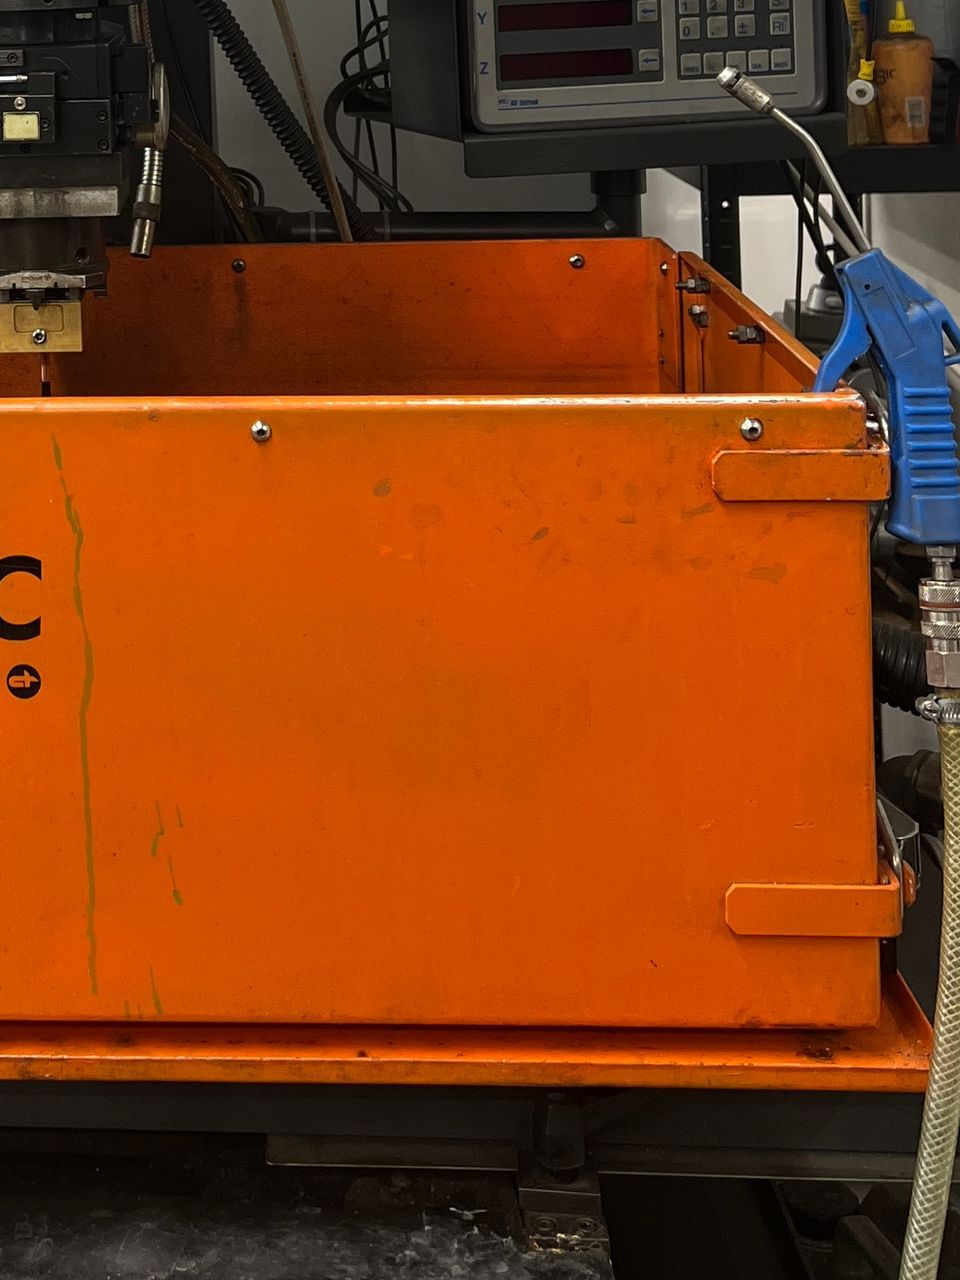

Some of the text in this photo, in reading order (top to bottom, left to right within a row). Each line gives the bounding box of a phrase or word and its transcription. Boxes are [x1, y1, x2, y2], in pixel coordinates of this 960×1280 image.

[681, 0, 688, 12] 1
[709, 0, 718, 11] 2
[476, 11, 487, 25] Y
[682, 26, 690, 37] 0
[479, 61, 489, 75] Z
